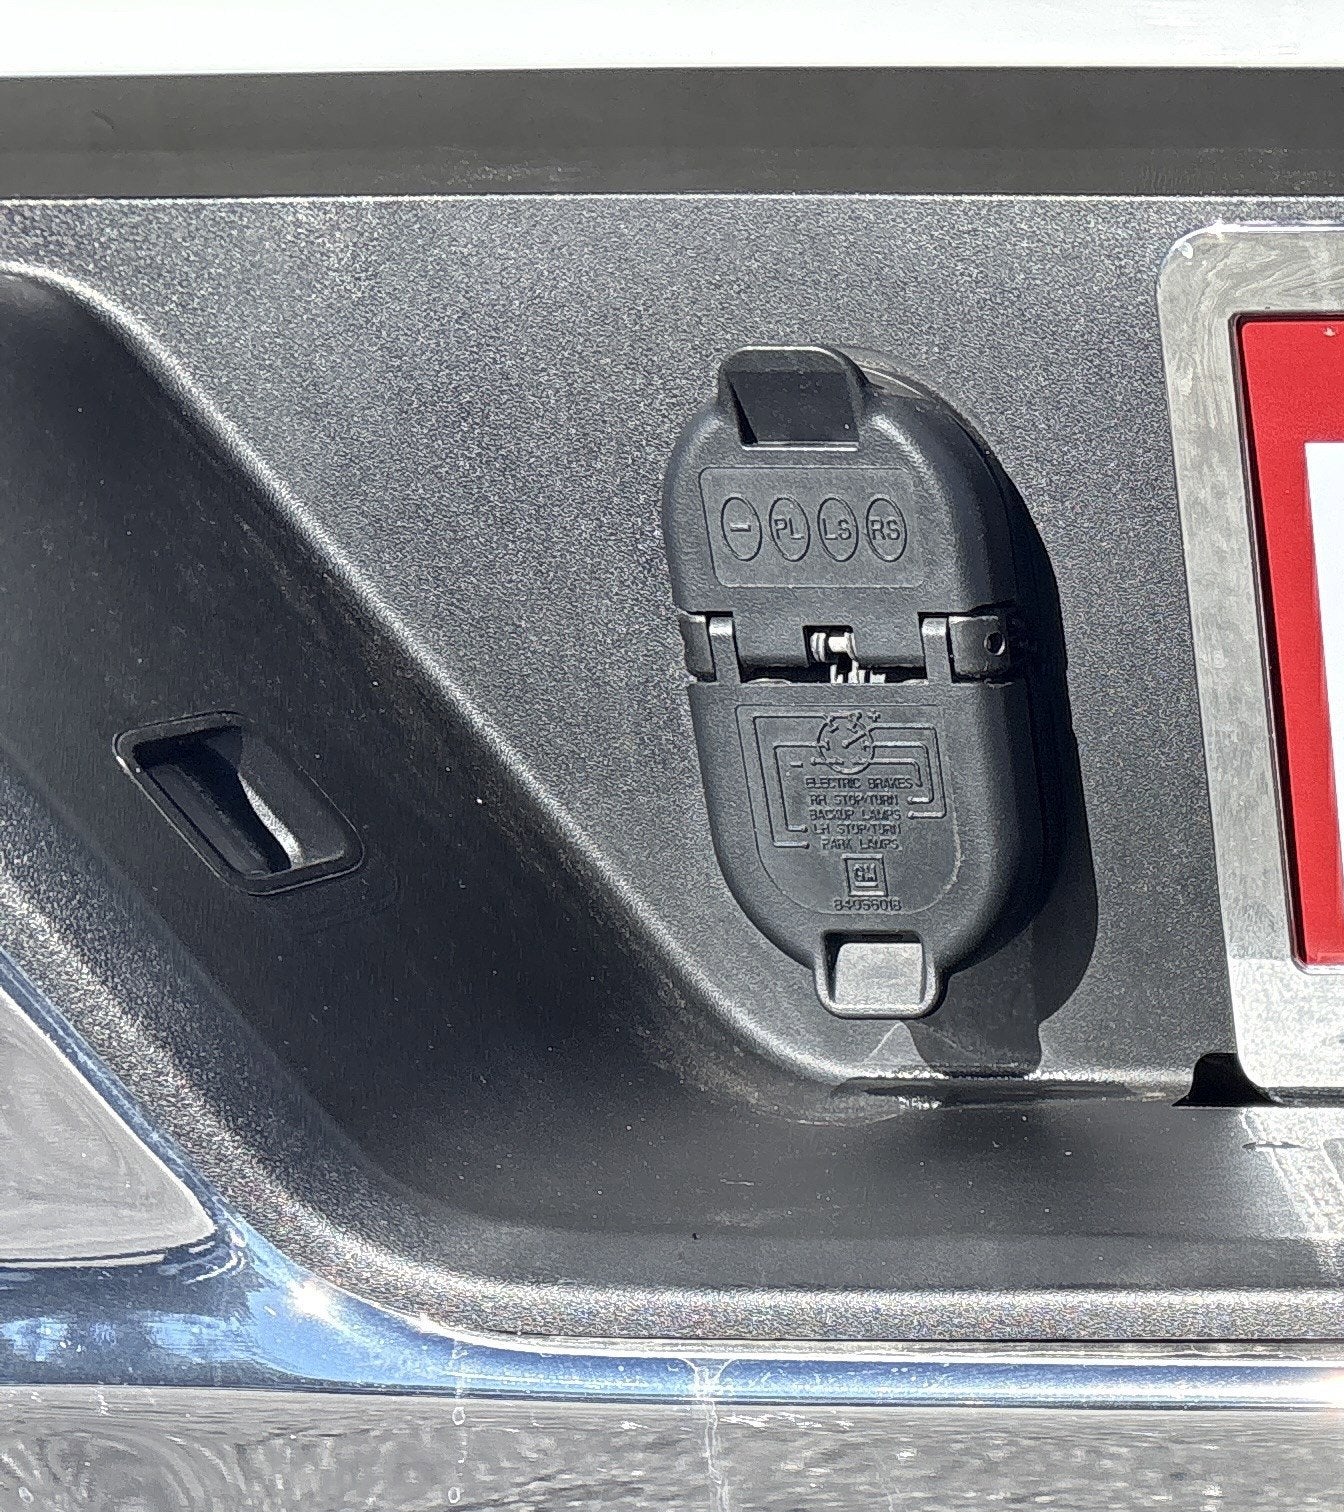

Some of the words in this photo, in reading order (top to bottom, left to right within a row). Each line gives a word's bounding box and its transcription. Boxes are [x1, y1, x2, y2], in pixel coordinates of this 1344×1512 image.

[774, 518, 804, 541] PL
[822, 518, 852, 541] LS
[870, 519, 901, 541] RS
[805, 776, 861, 789] ELECTRIC
[868, 776, 914, 789] BRAKES
